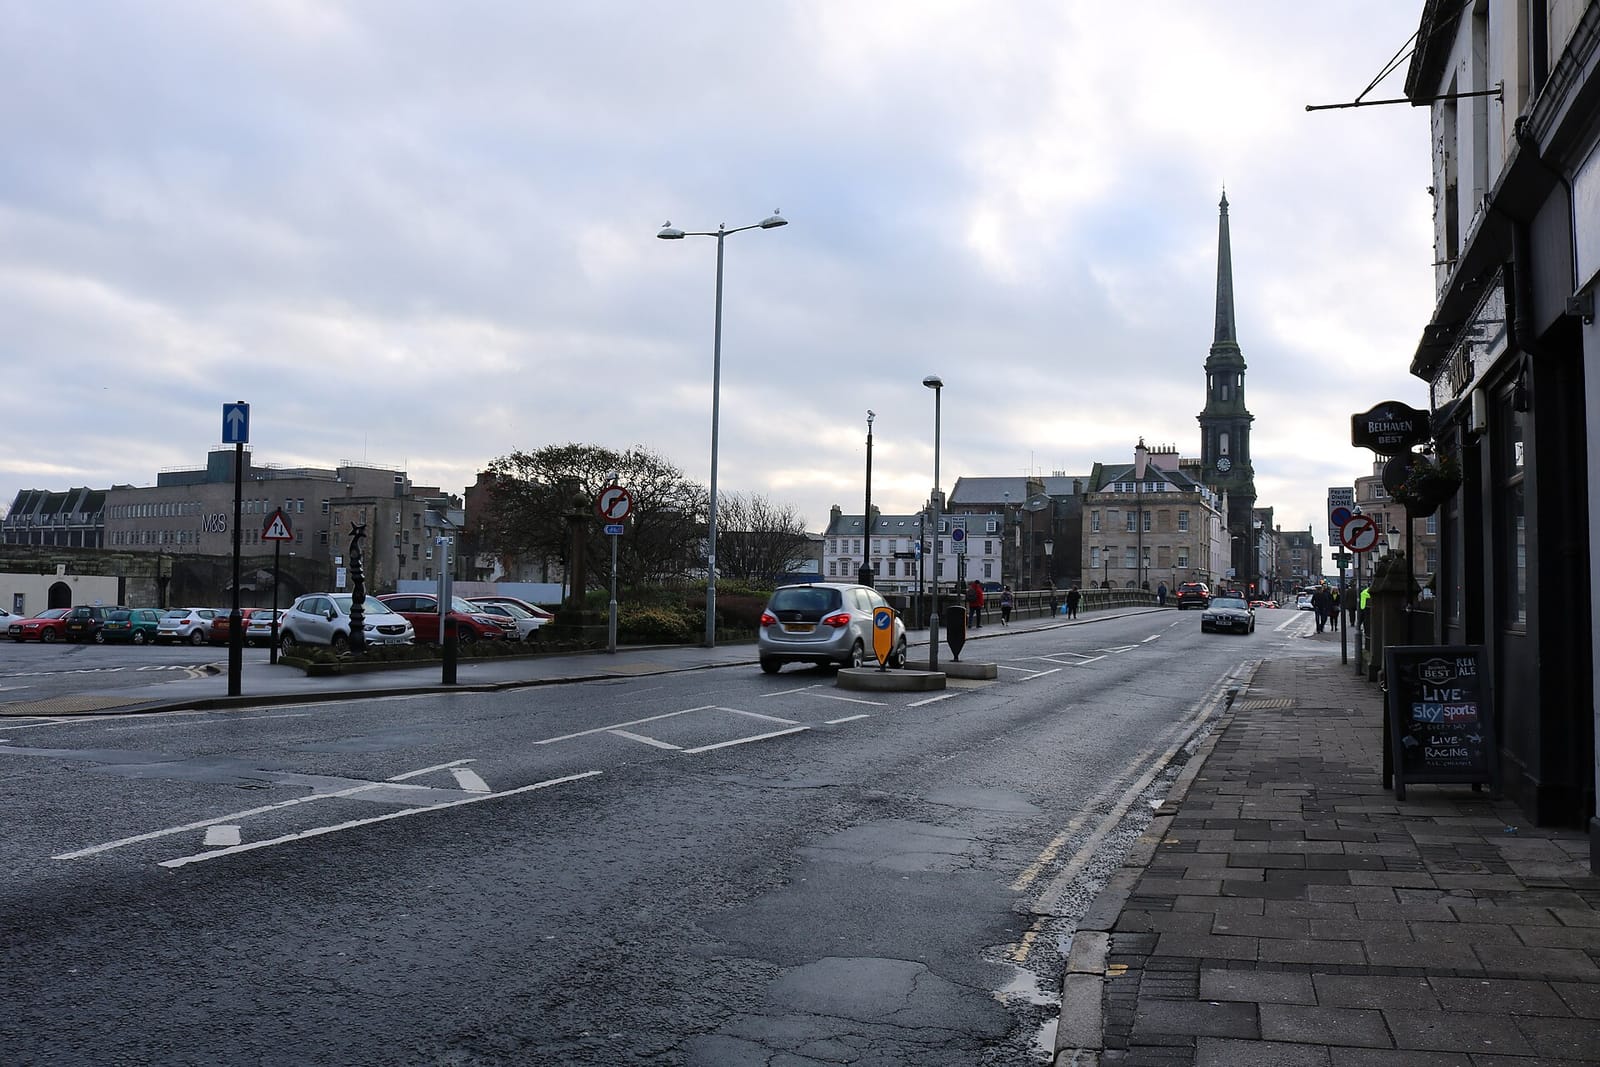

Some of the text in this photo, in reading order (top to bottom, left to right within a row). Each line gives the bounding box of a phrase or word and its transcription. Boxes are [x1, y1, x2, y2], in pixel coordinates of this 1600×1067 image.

[1368, 420, 1413, 433] BELHAVEN
[1378, 435, 1404, 445] BEST
[202, 513, 226, 533] M&S
[1424, 669, 1451, 678] BEST
[1458, 666, 1476, 676] ALE
[1423, 685, 1461, 701] LIVE
[1413, 704, 1477, 722] sky sports
[1431, 735, 1459, 745] LIVE
[1424, 747, 1469, 758] RACING
